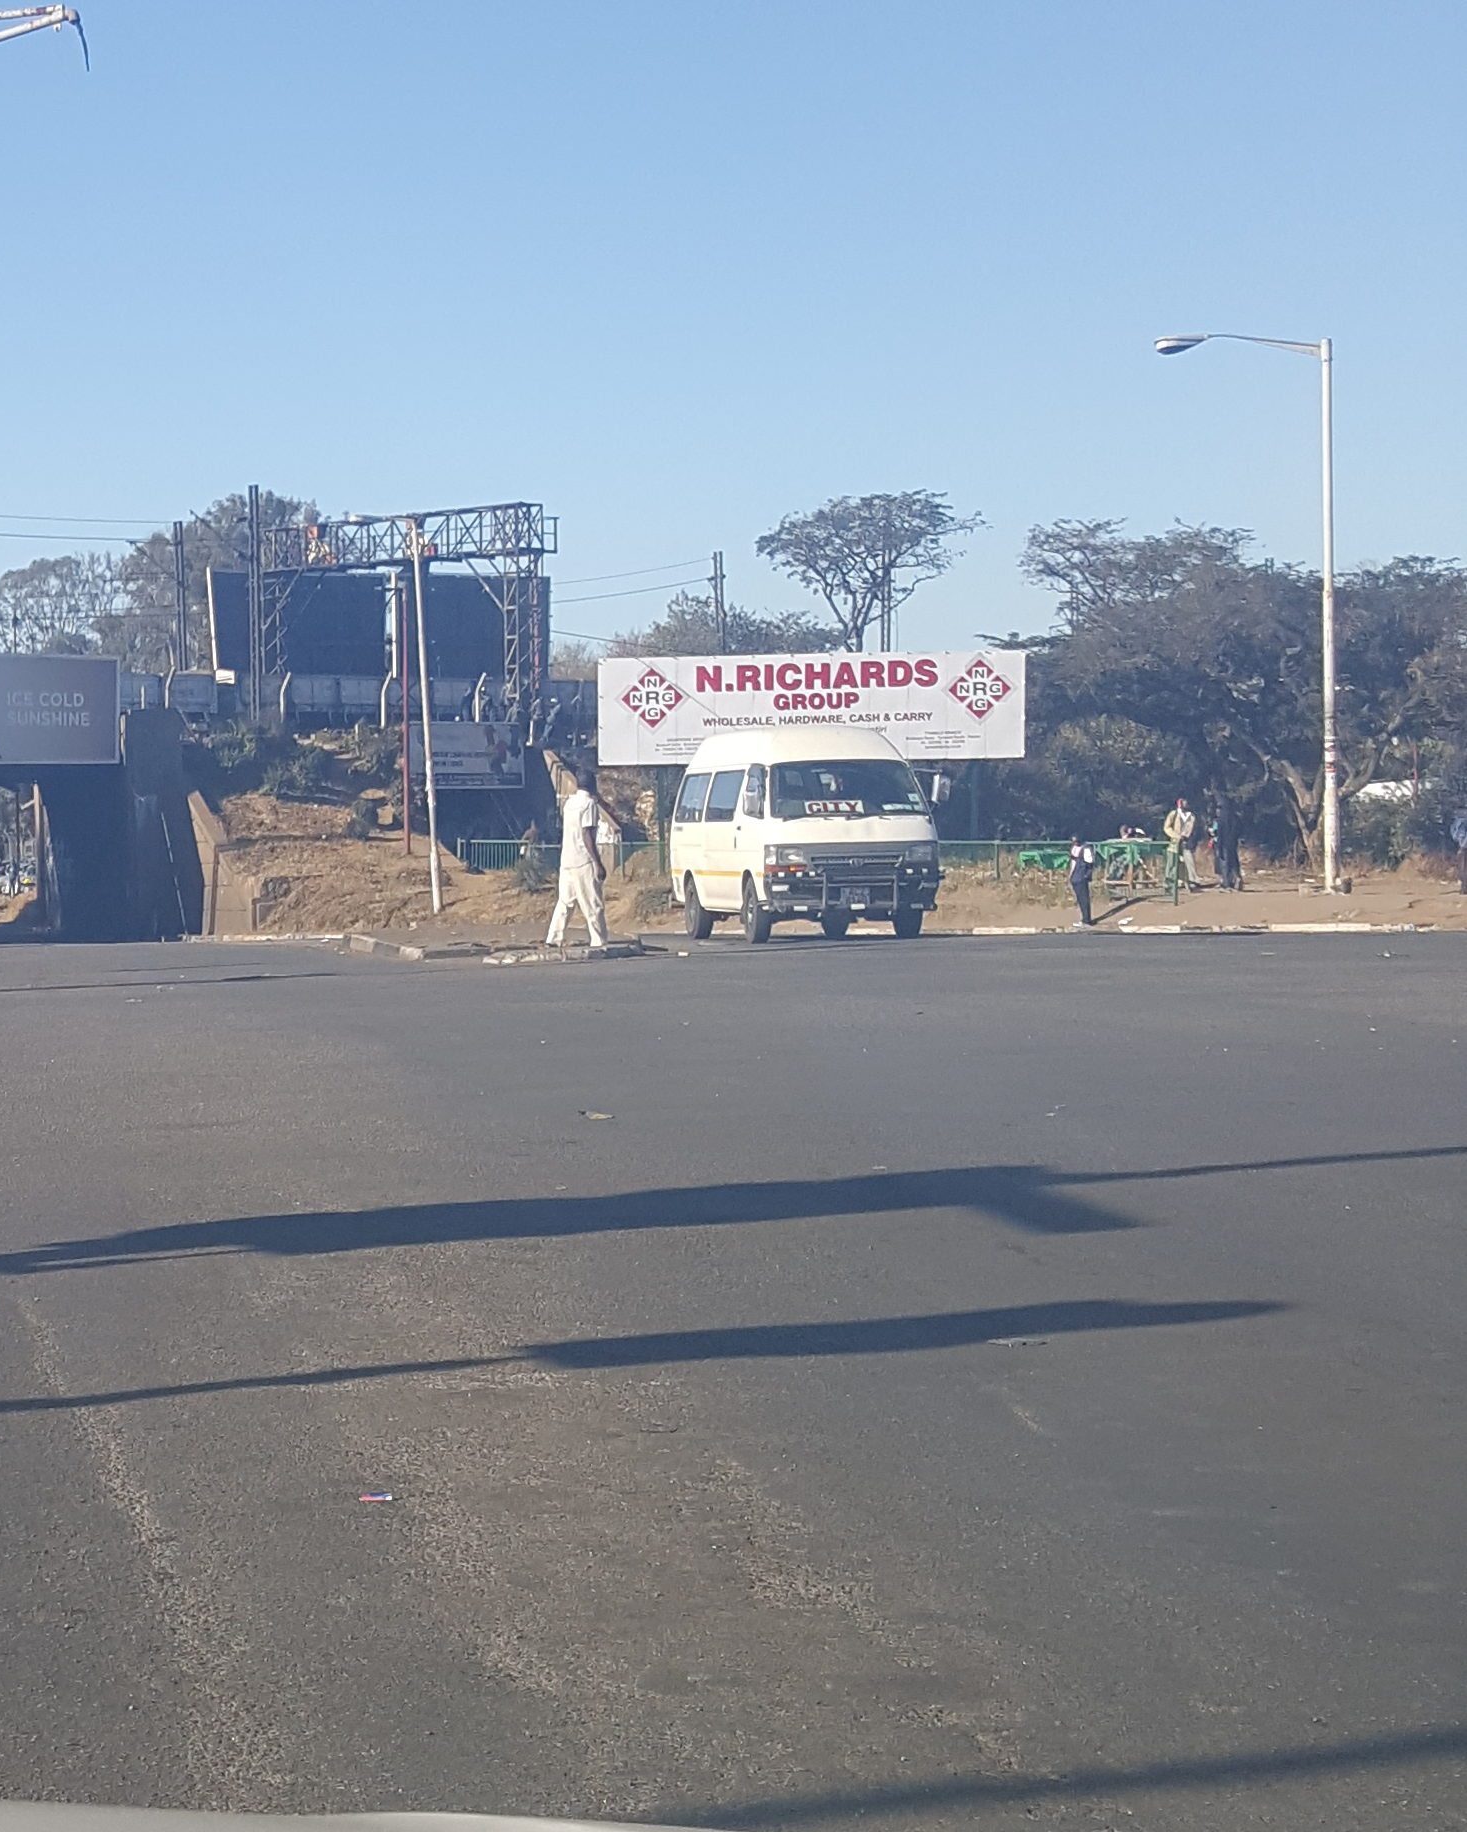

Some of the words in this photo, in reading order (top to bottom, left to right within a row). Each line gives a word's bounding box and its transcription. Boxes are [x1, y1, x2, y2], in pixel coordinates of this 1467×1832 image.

[696, 659, 939, 692] N.RICHARDS
[7, 692, 33, 706] ICE
[39, 692, 85, 707] COLD
[773, 692, 860, 711] GROUP
[8, 711, 91, 727] SUNSHINE
[702, 716, 776, 727] WHOLESALE,
[779, 714, 846, 725] HARDWARE,
[849, 713, 882, 723] CASH
[883, 713, 892, 722] &
[894, 712, 933, 722] CARRY
[807, 802, 859, 813] CITY
